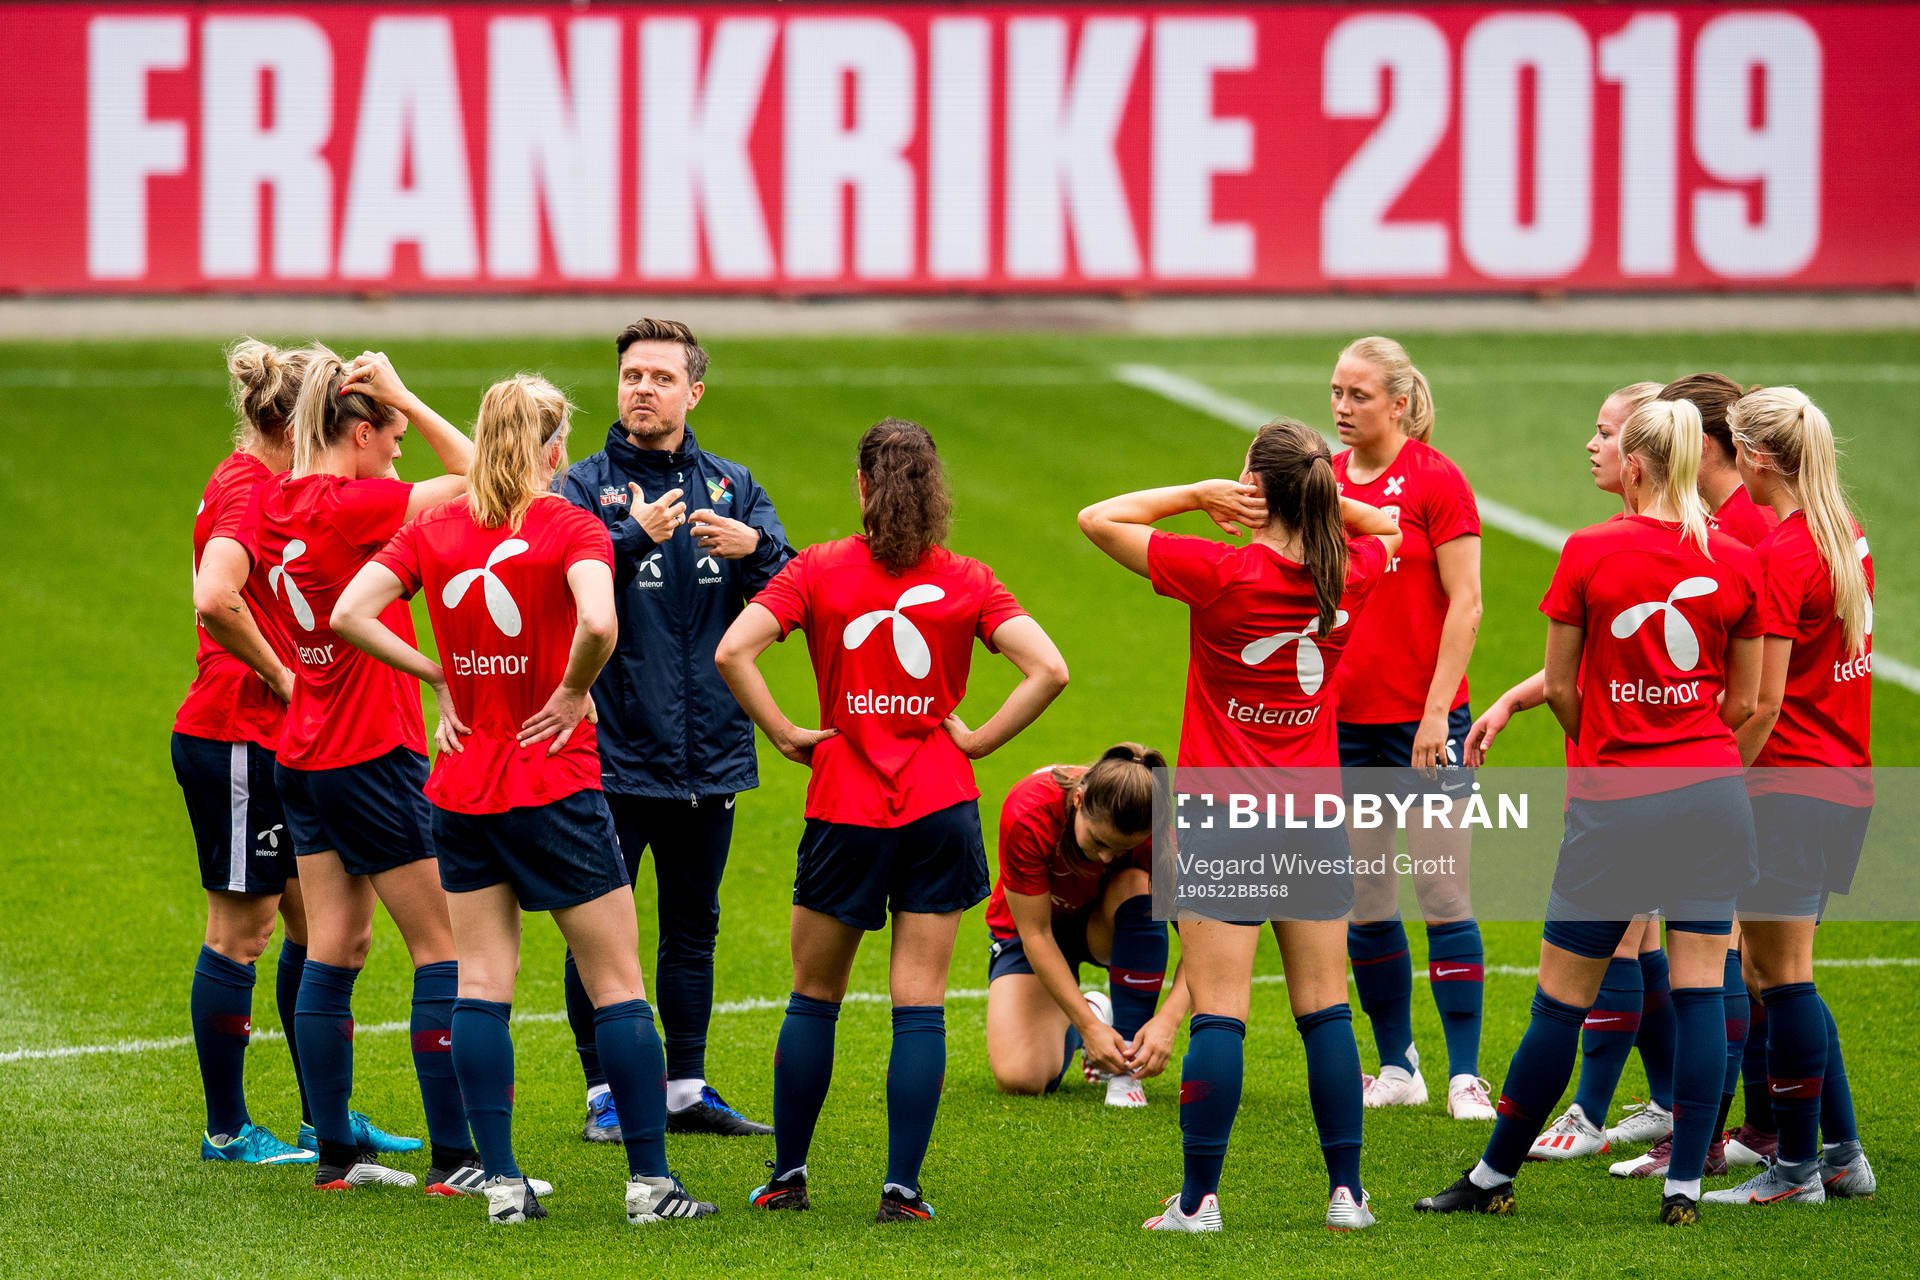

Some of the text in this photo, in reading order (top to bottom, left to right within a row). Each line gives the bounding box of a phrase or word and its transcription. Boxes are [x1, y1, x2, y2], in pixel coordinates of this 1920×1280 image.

[86, 12, 1824, 281] FRANKRIKE 2019
[602, 494, 623, 504] TINE
[639, 580, 663, 588] telenor
[698, 576, 722, 585] telenor
[452, 649, 529, 676] telenor
[846, 688, 935, 716] telenor
[1609, 679, 1700, 705] telenor
[1227, 697, 1321, 726] telenor
